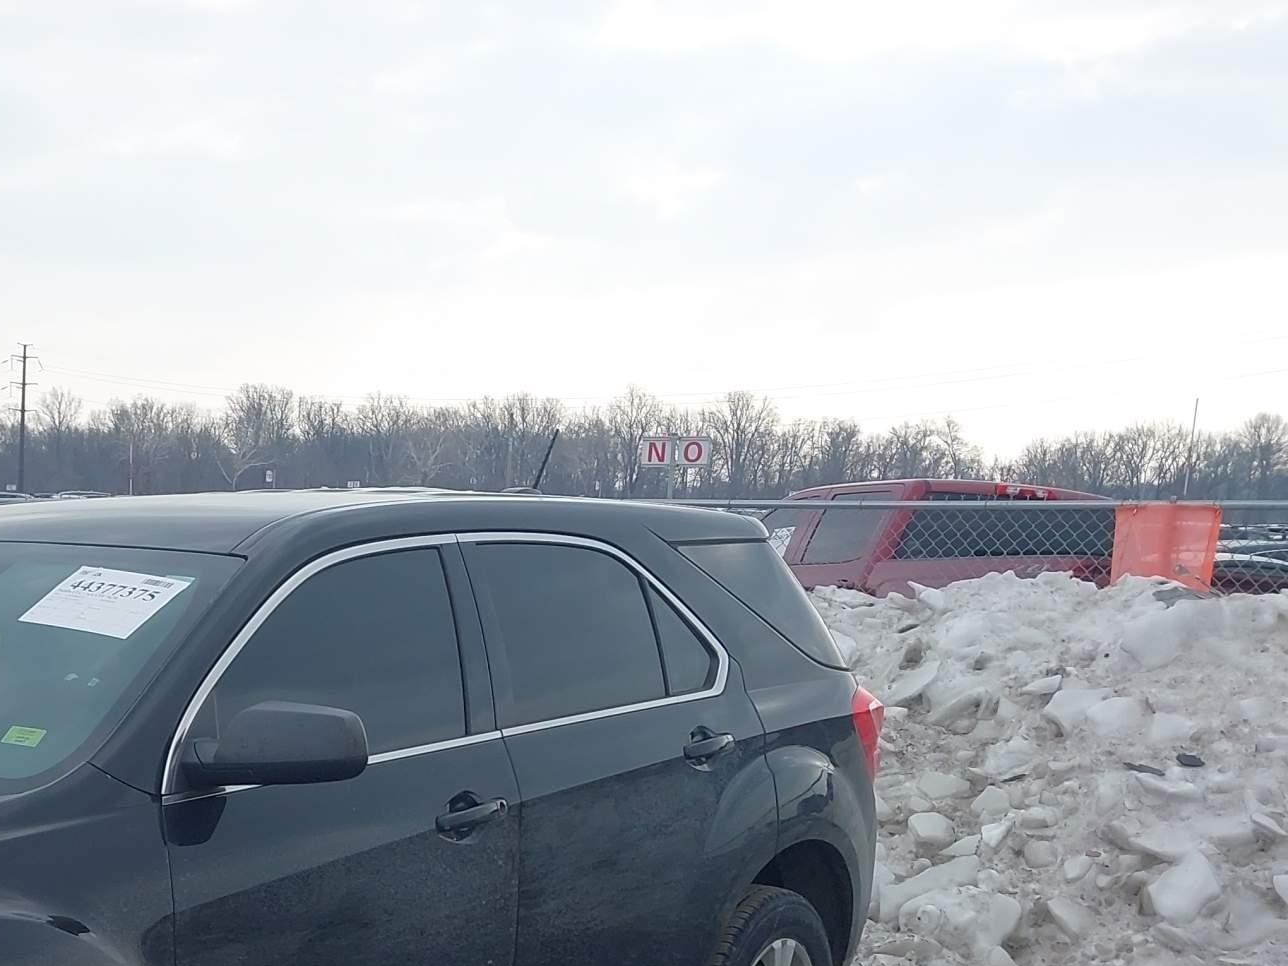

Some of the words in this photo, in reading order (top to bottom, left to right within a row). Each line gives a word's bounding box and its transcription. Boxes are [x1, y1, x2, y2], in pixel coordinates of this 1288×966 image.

[647, 441, 666, 463] N
[683, 441, 703, 463] O
[70, 579, 161, 602] 44377375
